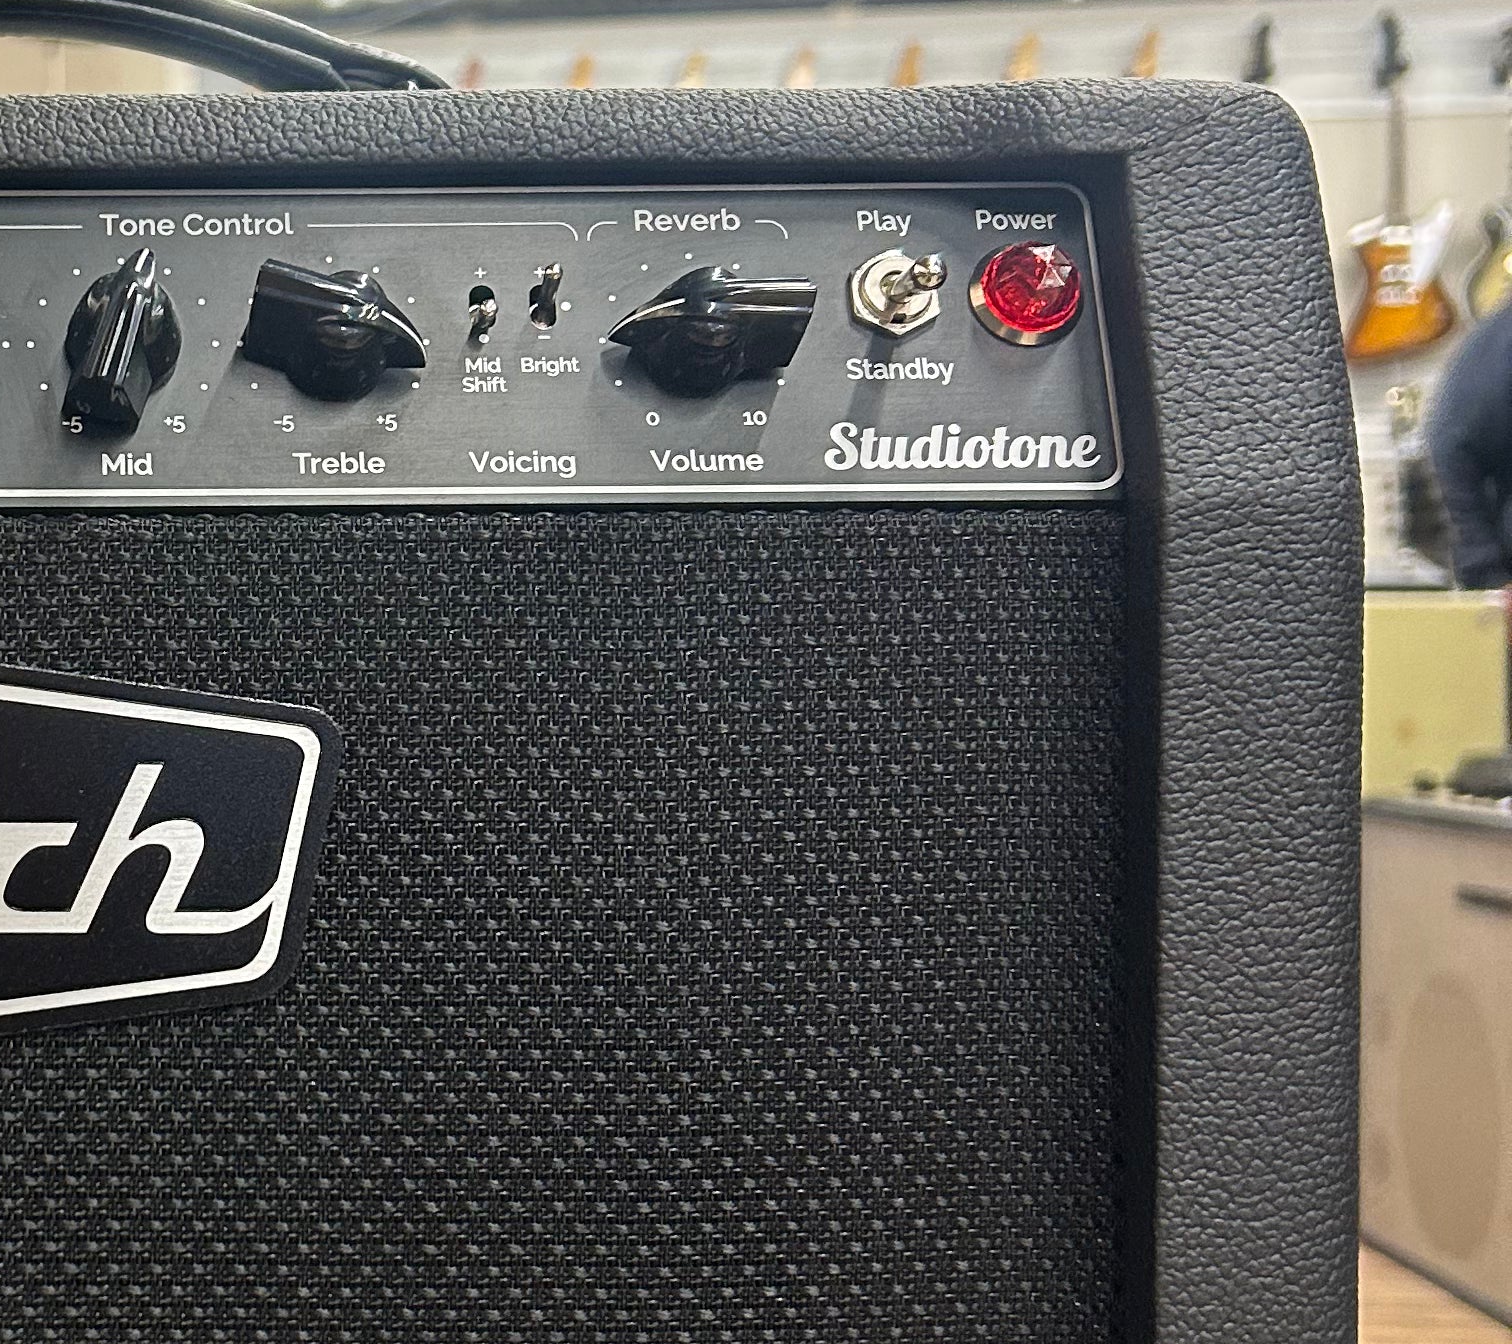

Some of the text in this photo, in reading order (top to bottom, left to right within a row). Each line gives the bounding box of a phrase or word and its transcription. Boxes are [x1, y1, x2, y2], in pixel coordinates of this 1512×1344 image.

[98, 212, 295, 237] Tone Control
[633, 208, 741, 232] Reverb
[856, 209, 912, 237] Play
[975, 209, 1057, 231] Power
[464, 356, 502, 374] Mid
[520, 356, 581, 377] Bright
[845, 357, 955, 386] Standby
[461, 375, 509, 393] Shift
[61, 416, 85, 434] -5
[163, 415, 186, 434] +5
[273, 414, 295, 433] -5
[376, 414, 398, 432] +5
[645, 411, 660, 426] 0
[742, 410, 768, 426] 10
[824, 421, 1101, 471] Studiotone
[101, 452, 154, 476] Mid
[291, 451, 386, 475] Treble
[468, 450, 577, 479] Voicing
[649, 448, 764, 472] Volume
